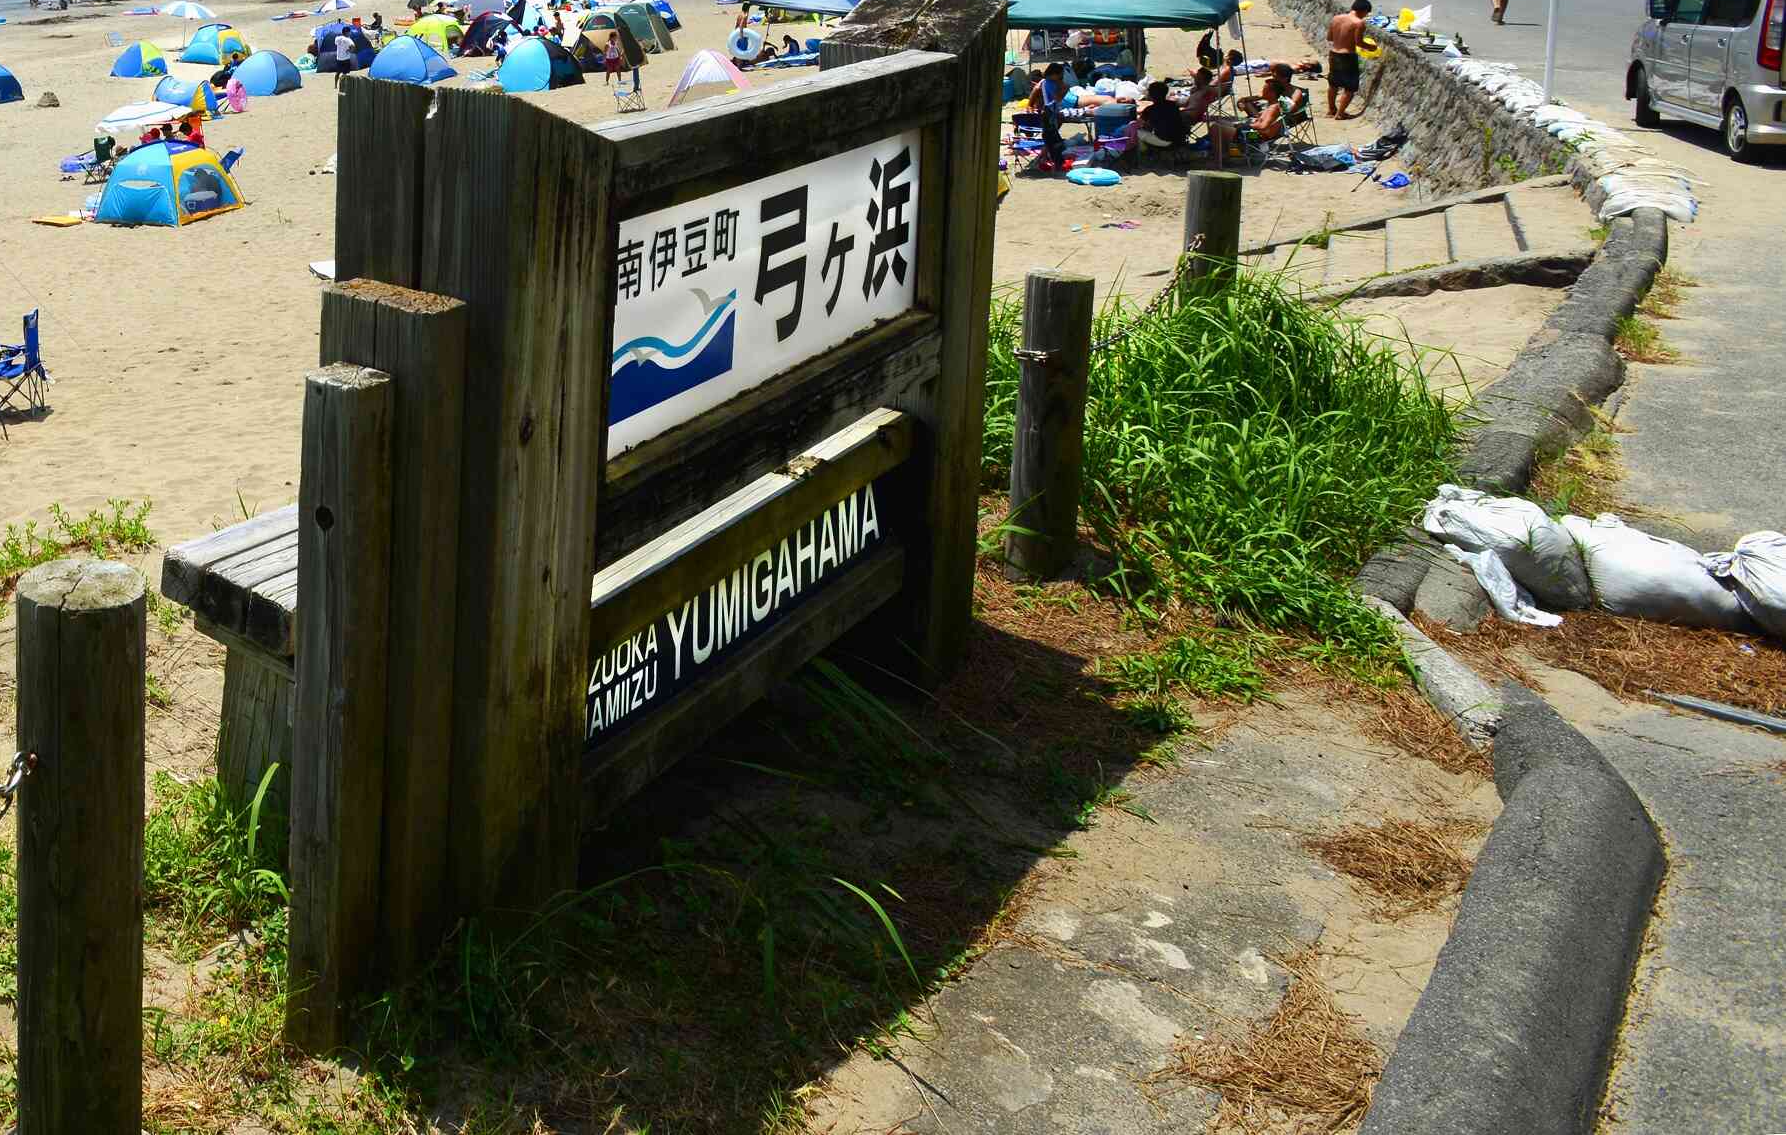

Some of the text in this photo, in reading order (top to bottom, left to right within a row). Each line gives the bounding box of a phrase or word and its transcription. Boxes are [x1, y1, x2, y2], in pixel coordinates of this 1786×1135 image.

[615, 207, 740, 301] 南伊豆町
[665, 480, 881, 681] YUMIGAHAMA
[584, 660, 658, 742] AMIIZU
